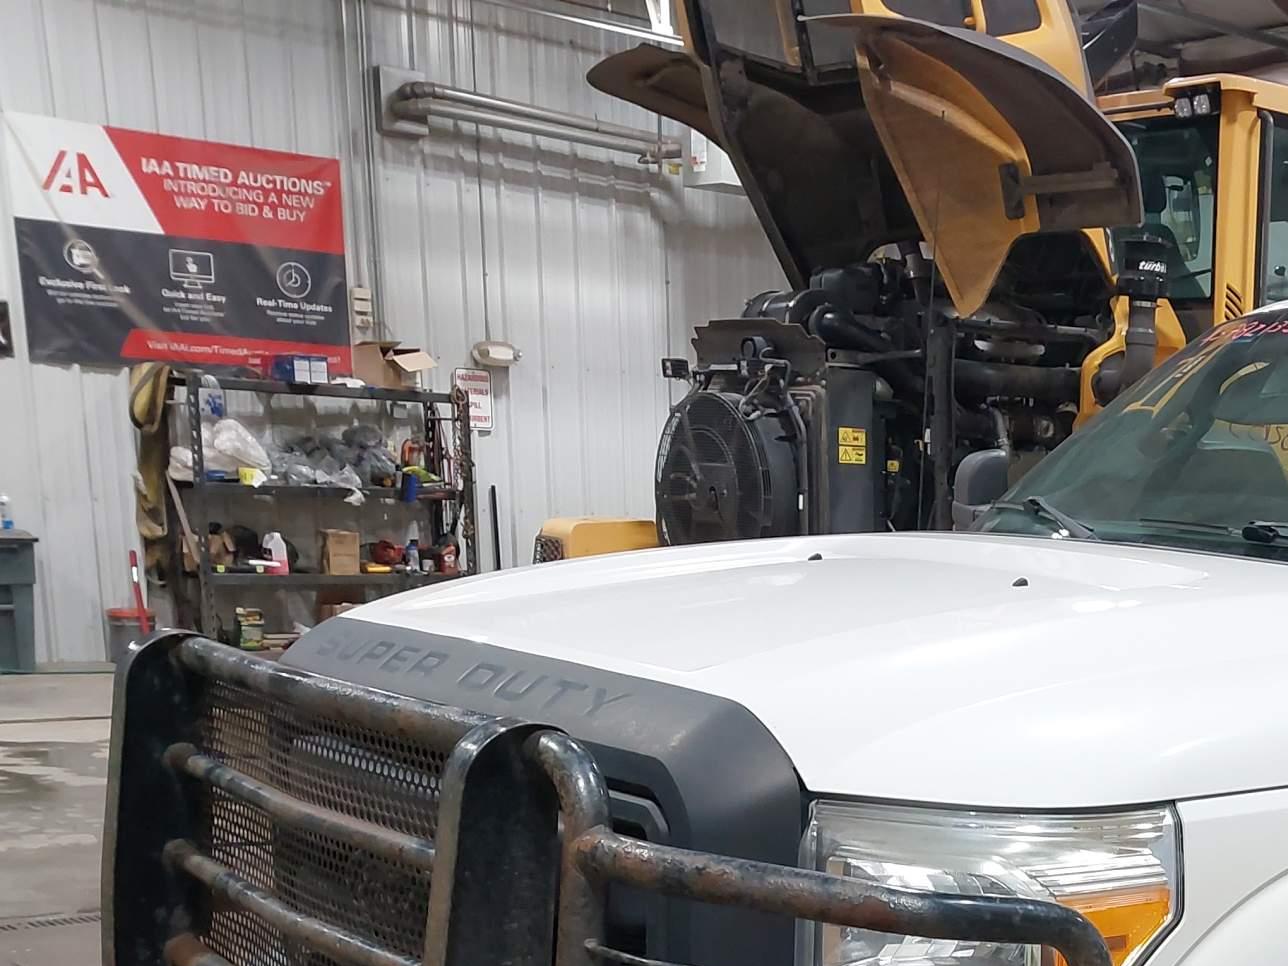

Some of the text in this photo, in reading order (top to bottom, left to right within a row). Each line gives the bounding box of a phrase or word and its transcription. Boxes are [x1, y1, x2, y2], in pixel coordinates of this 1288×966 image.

[140, 157, 174, 177] IAA
[175, 162, 232, 182] TIMED
[163, 179, 315, 208] INTRODUCING A NEW
[173, 195, 307, 222] WAY TO BID & BUY
[161, 288, 185, 299] Quick
[206, 292, 226, 304] Easy
[256, 297, 333, 313] Real-Time Updates
[316, 637, 635, 716] SUPER DUTY
